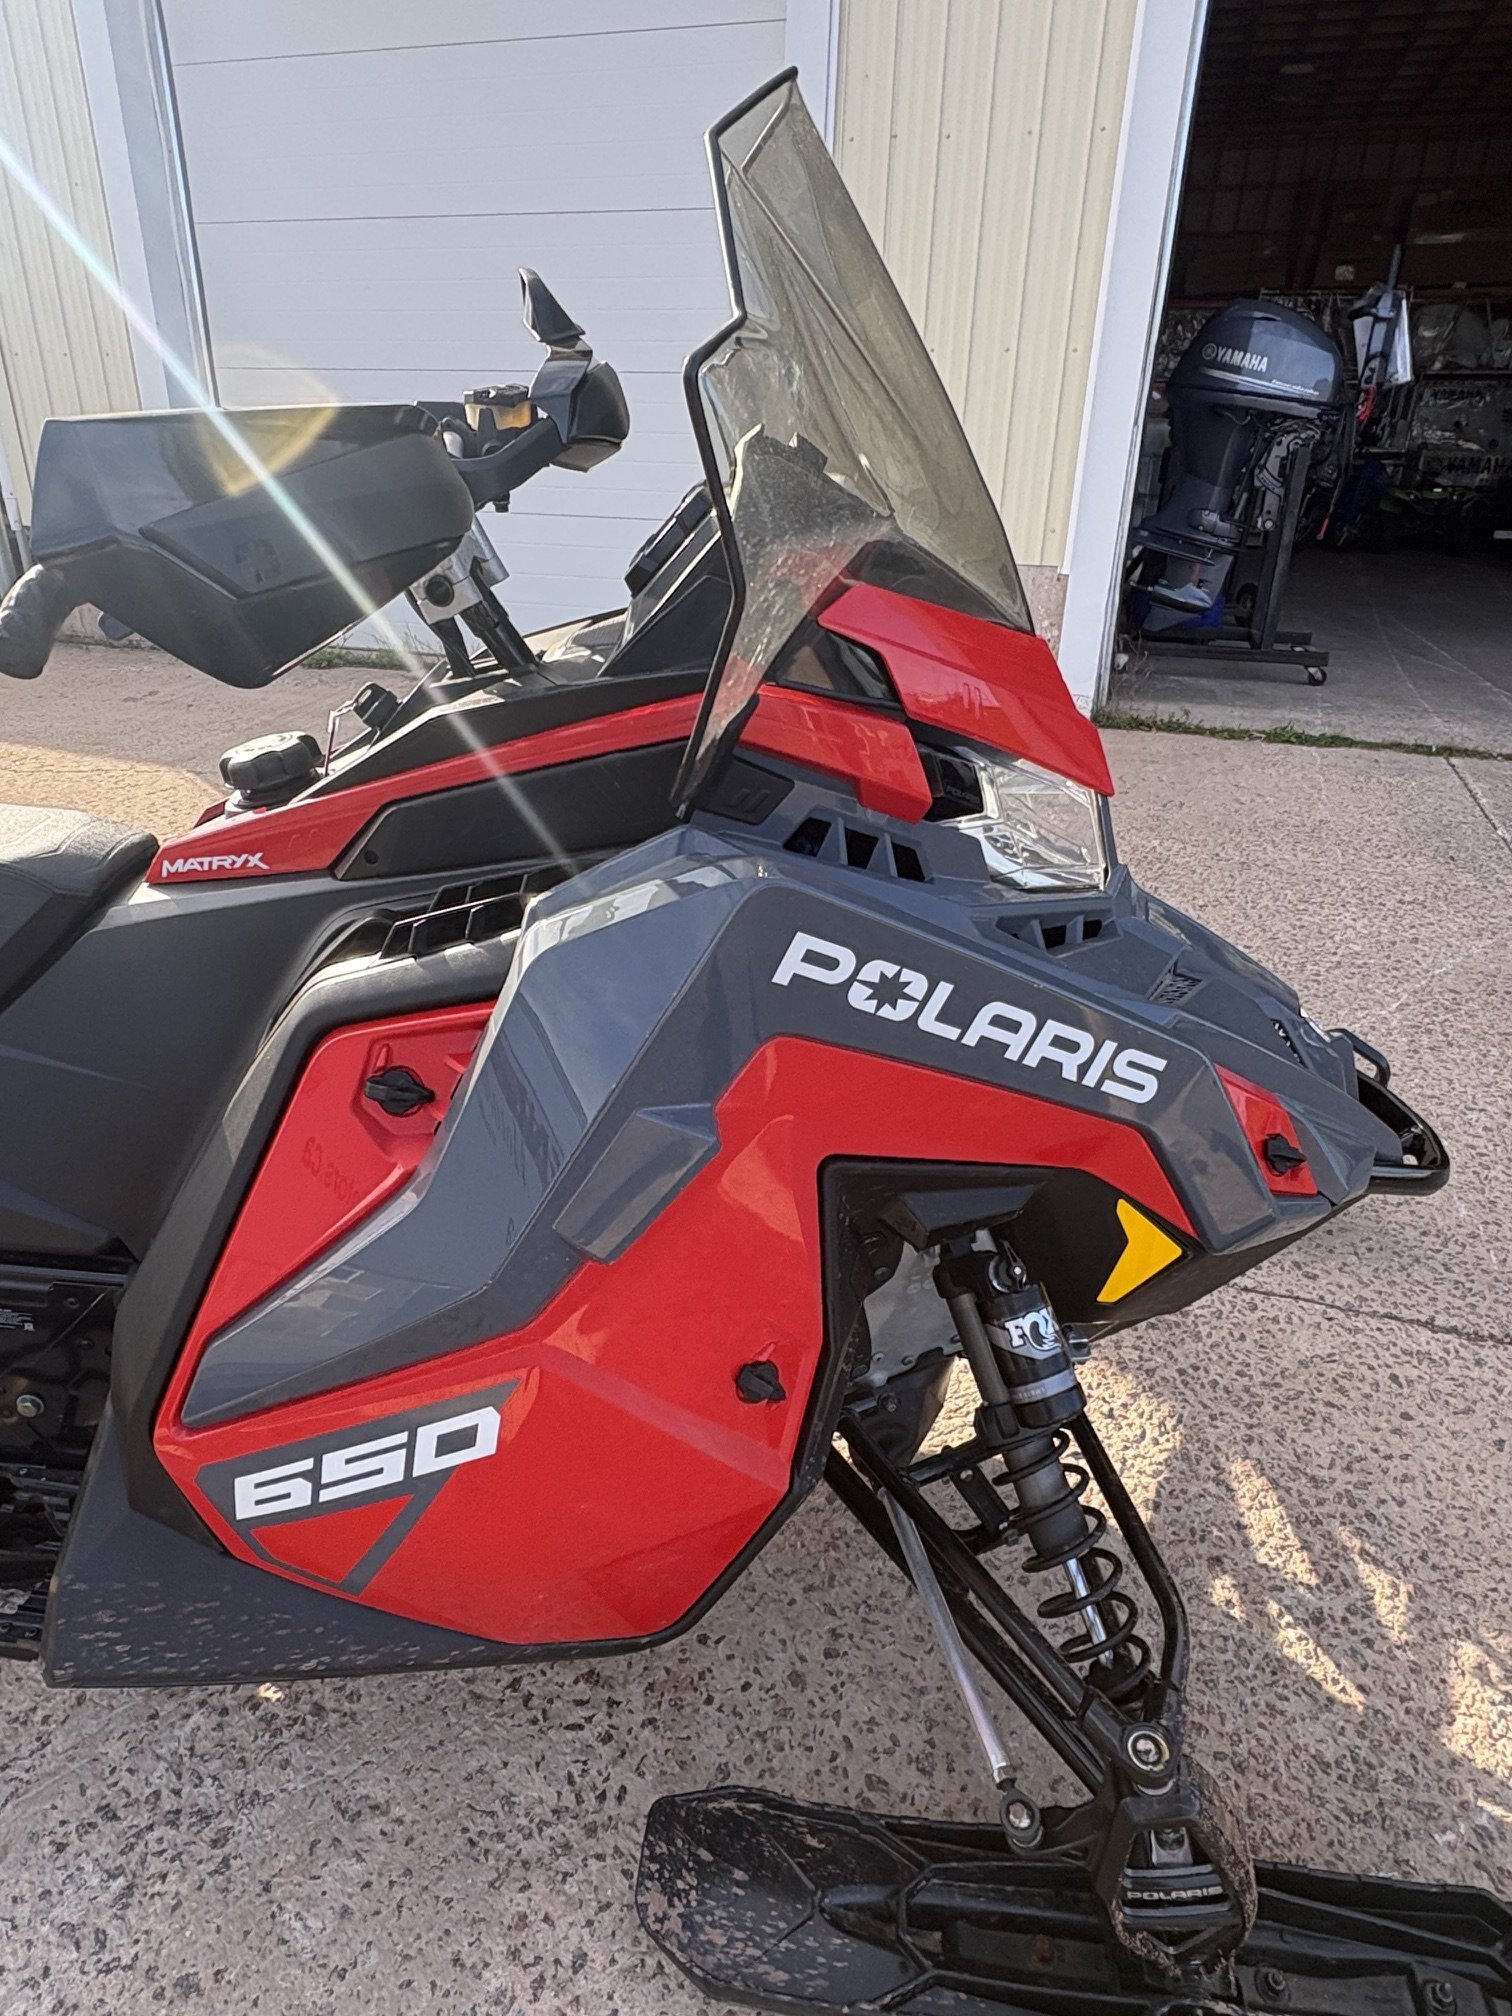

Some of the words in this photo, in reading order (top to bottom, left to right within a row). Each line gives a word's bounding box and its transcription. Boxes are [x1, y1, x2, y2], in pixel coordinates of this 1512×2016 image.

[1216, 346, 1269, 373] YAMAHA
[161, 852, 271, 878] MATRYX
[771, 931, 1168, 1104] POLARIS
[234, 1406, 501, 1520] 650
[1125, 1885, 1224, 1901] POLARIS
